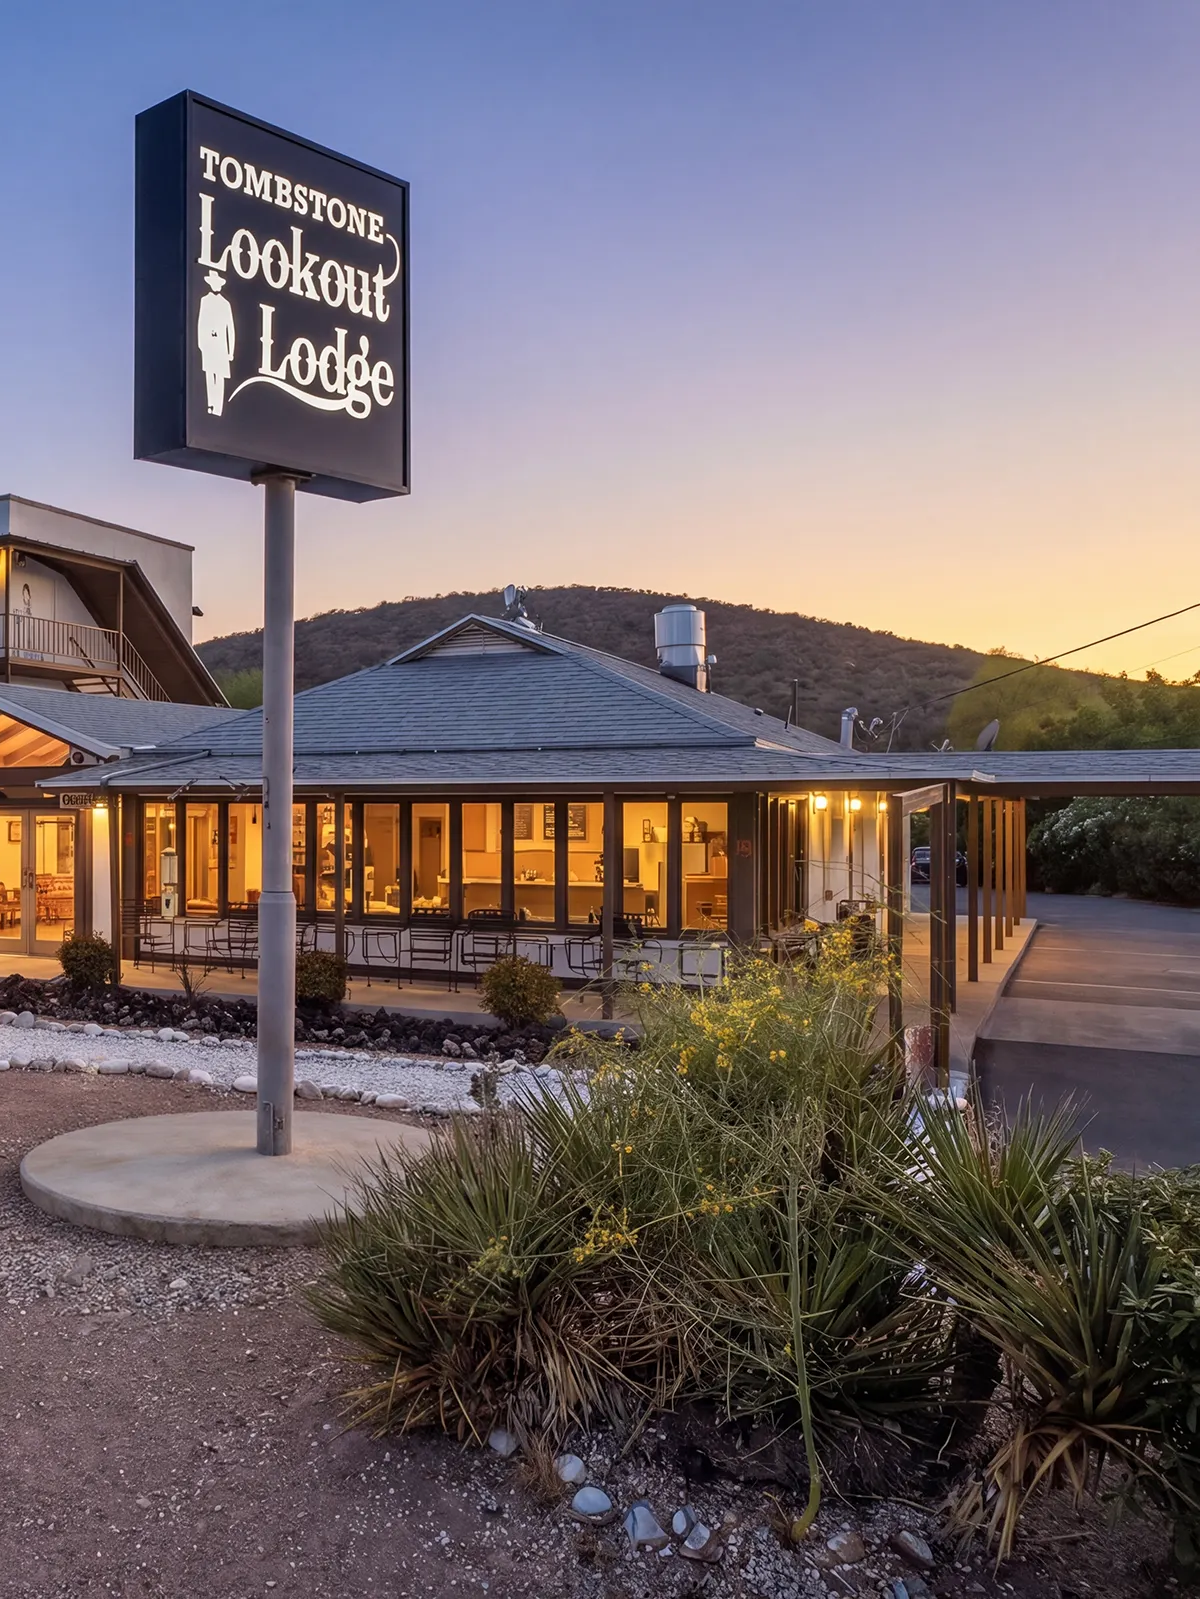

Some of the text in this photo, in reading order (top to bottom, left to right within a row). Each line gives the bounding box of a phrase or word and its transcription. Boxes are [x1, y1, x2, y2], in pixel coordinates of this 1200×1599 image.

[199, 145, 384, 245] TOMBSTONE
[197, 192, 401, 323] Lookout
[228, 302, 396, 420] Lodge
